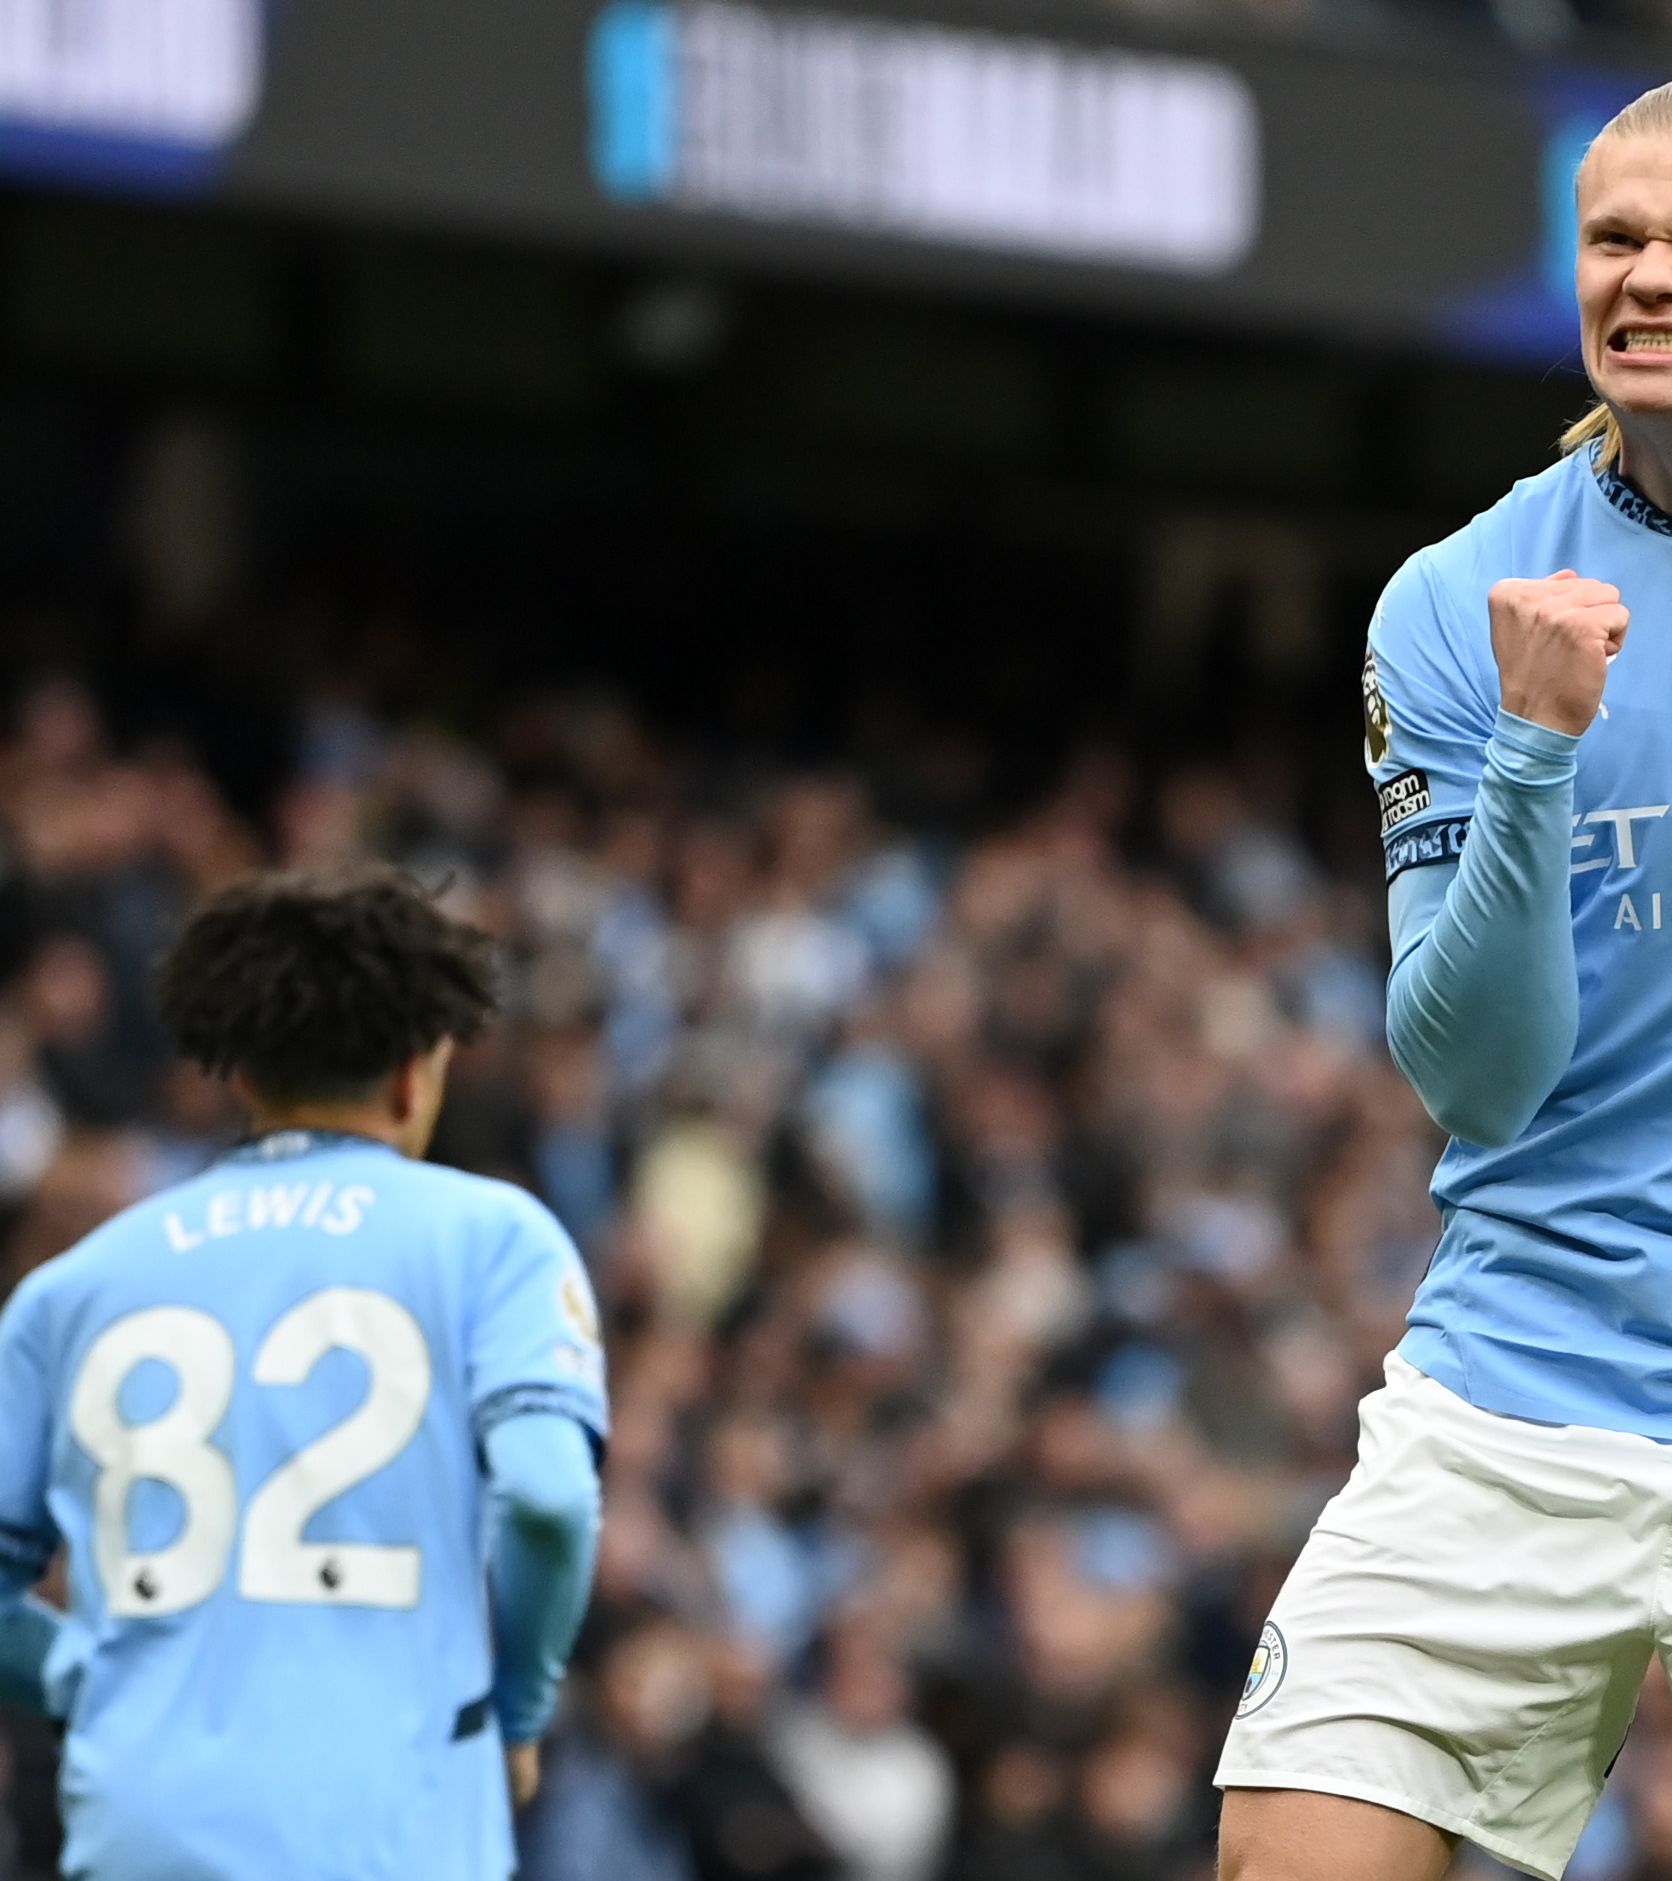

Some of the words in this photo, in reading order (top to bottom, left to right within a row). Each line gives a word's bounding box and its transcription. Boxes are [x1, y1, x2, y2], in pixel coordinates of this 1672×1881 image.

[1382, 774, 1419, 807] room
[163, 1180, 376, 1253] LEWIS
[70, 1286, 431, 1619] 82
